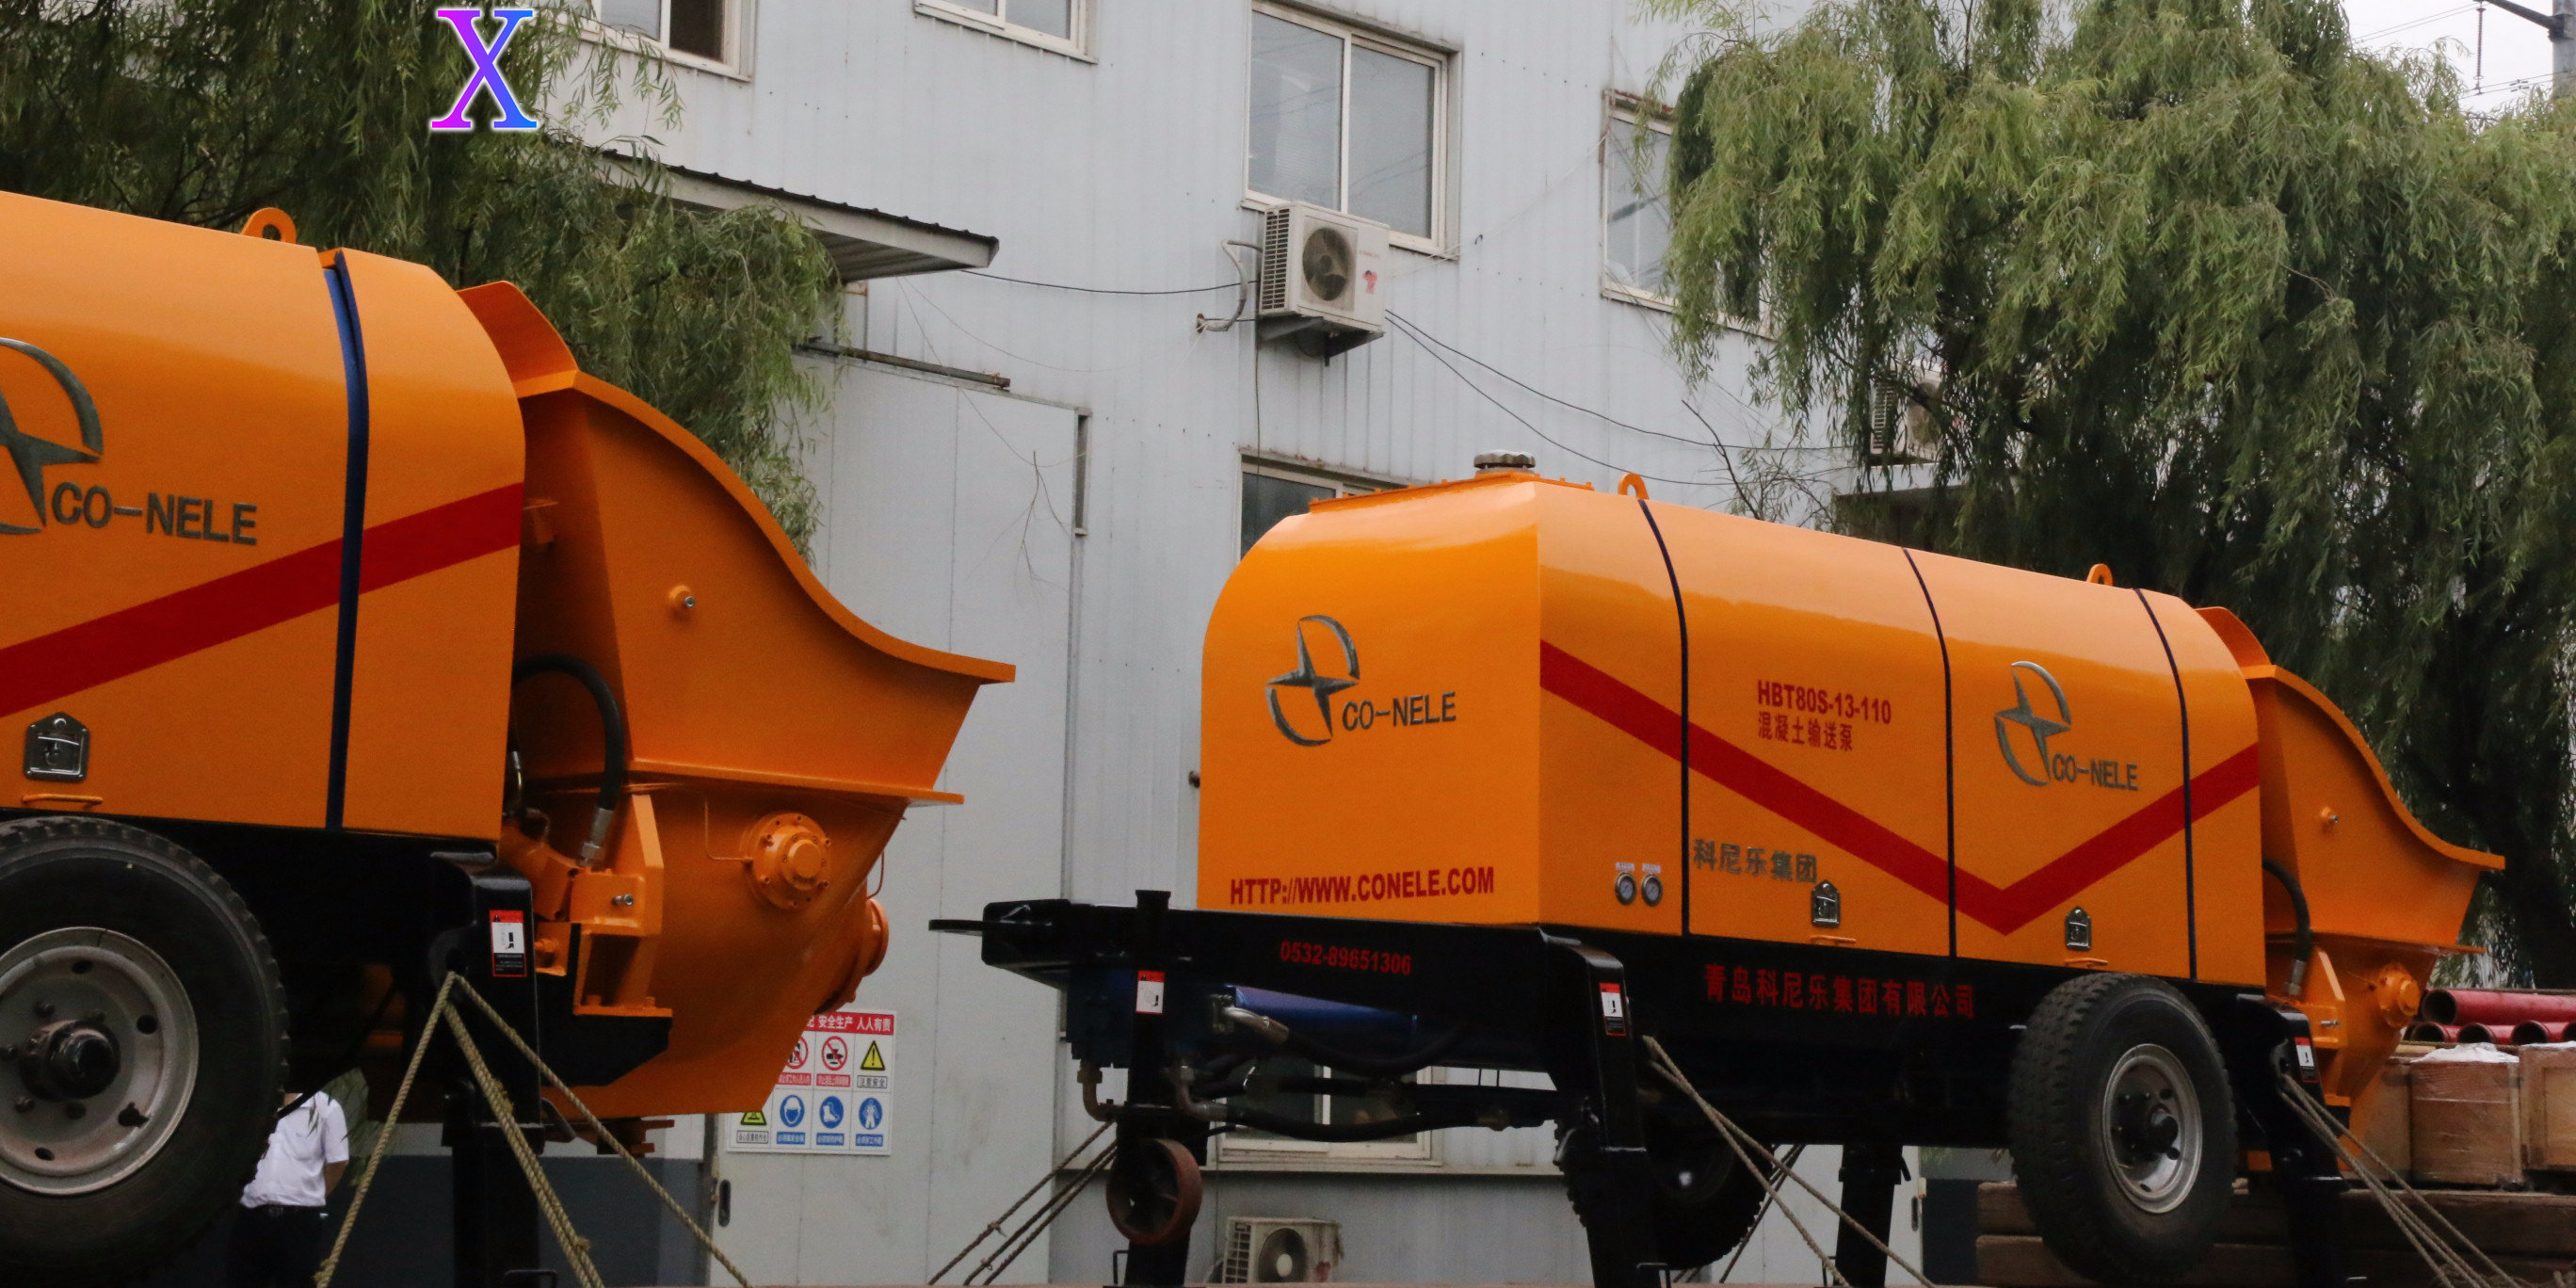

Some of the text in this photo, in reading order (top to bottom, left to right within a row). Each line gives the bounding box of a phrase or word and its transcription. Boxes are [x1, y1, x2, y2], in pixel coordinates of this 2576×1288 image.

[52, 482, 257, 545] CO-NELE
[1342, 691, 1457, 731] CO-NELE
[1758, 680, 1892, 724] HBT80S-13-110
[1758, 711, 1853, 751] 混凝土输送泵
[2053, 753, 2138, 791] CO-NELE
[1694, 838, 1818, 883] 科尼乐集团
[1231, 866, 1494, 905] HTTP://WWW.CONELE.COM
[1280, 940, 1411, 975] 0532-89651306
[1705, 962, 1975, 1019] 青岛科尼乐集团有限公司
